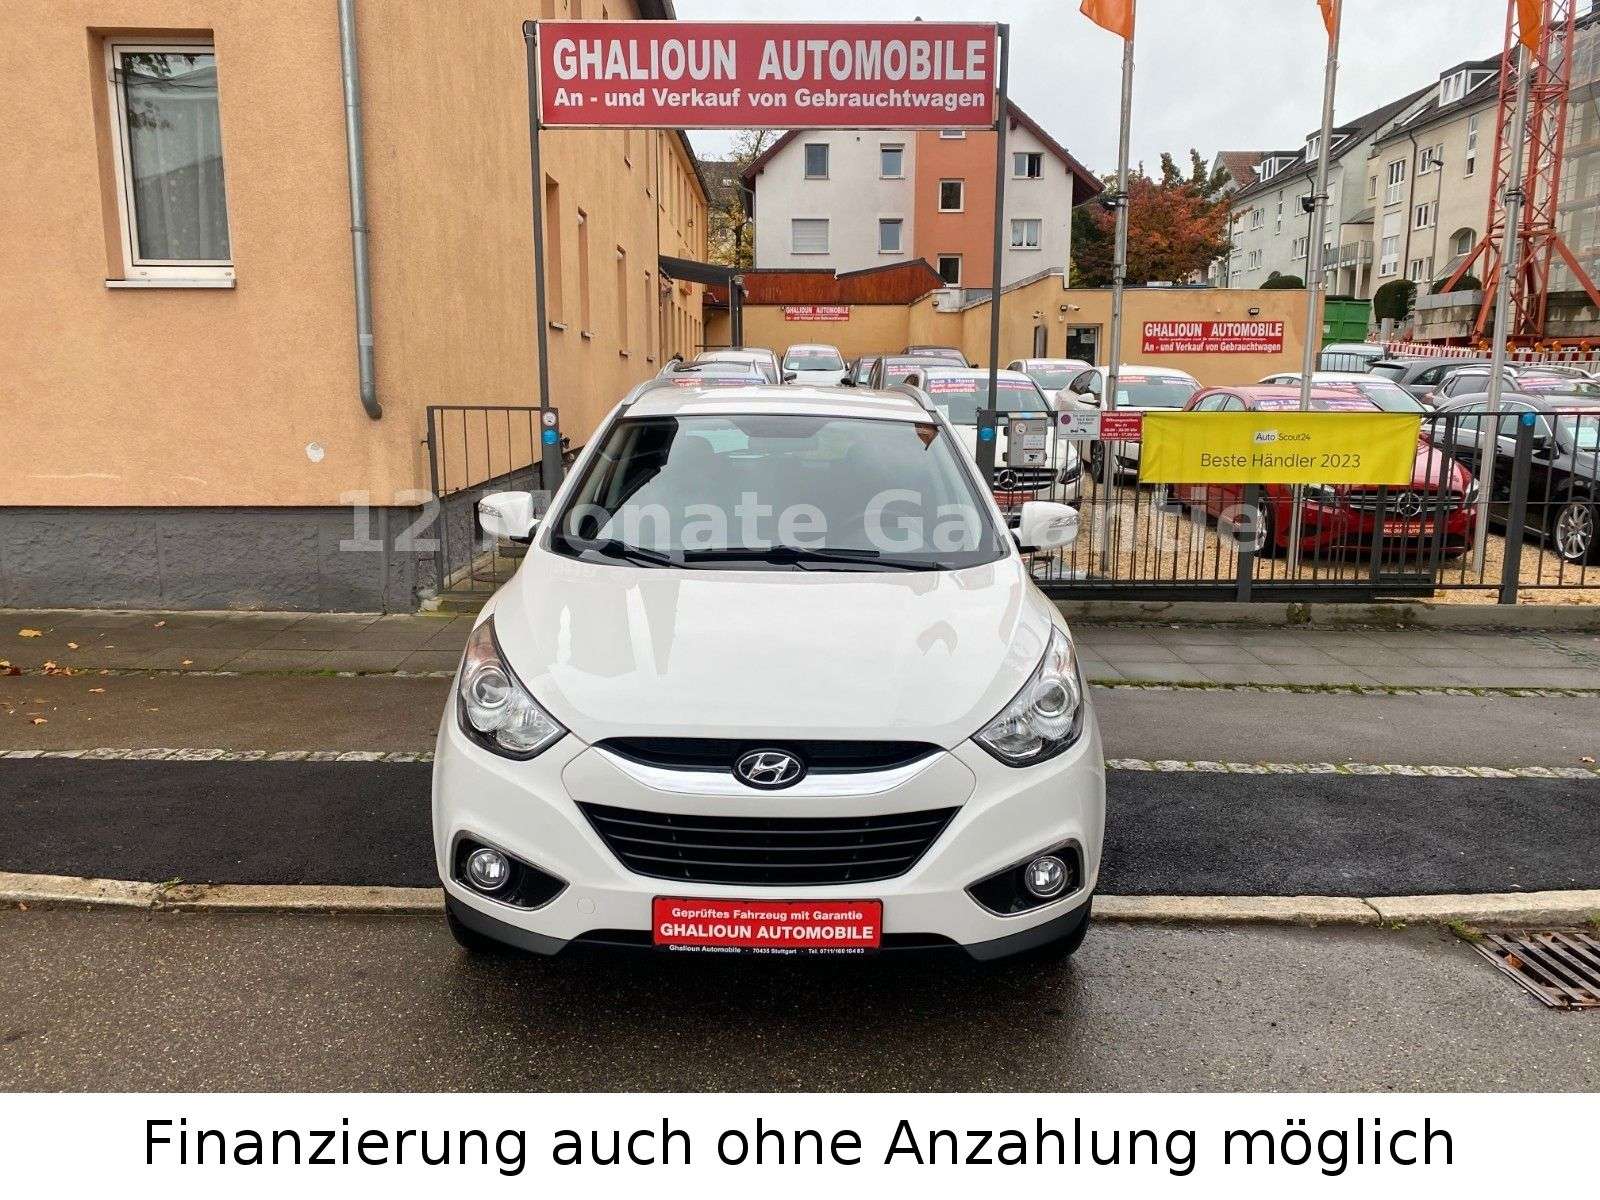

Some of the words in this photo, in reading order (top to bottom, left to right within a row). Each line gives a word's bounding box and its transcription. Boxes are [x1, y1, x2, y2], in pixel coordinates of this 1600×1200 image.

[553, 38, 737, 81] GHALIOUN
[759, 39, 987, 81] AUTOMOBILE
[554, 88, 584, 107] An
[605, 88, 645, 107] und
[652, 87, 741, 108] Verkauf
[748, 93, 787, 107] von
[795, 87, 986, 112] Gebrauchtwagen
[816, 306, 849, 314] AUTOMOBILE
[1145, 323, 1203, 337] GHALIOUN
[1211, 323, 1283, 337] AUTOMOBILE
[1144, 342, 1155, 352] An
[1160, 341, 1175, 352] und
[1176, 341, 1205, 352] Verkauf
[1206, 343, 1219, 352] von
[1220, 341, 1281, 354] Gebrauchtwagen
[1200, 453, 1247, 468] Beste
[1252, 453, 1317, 468] Händler
[1320, 453, 1361, 468] 2023
[671, 907, 730, 921] Geprüftes
[733, 909, 788, 922] Fahrzeug
[791, 910, 810, 920] mit
[812, 910, 863, 921] Garantie
[660, 922, 752, 939] GHALIOUN
[757, 924, 874, 940] AUTOMOBILE
[669, 944, 701, 953] Ghalioun
[702, 946, 742, 954] Automobile
[770, 947, 797, 955] Stuttgart
